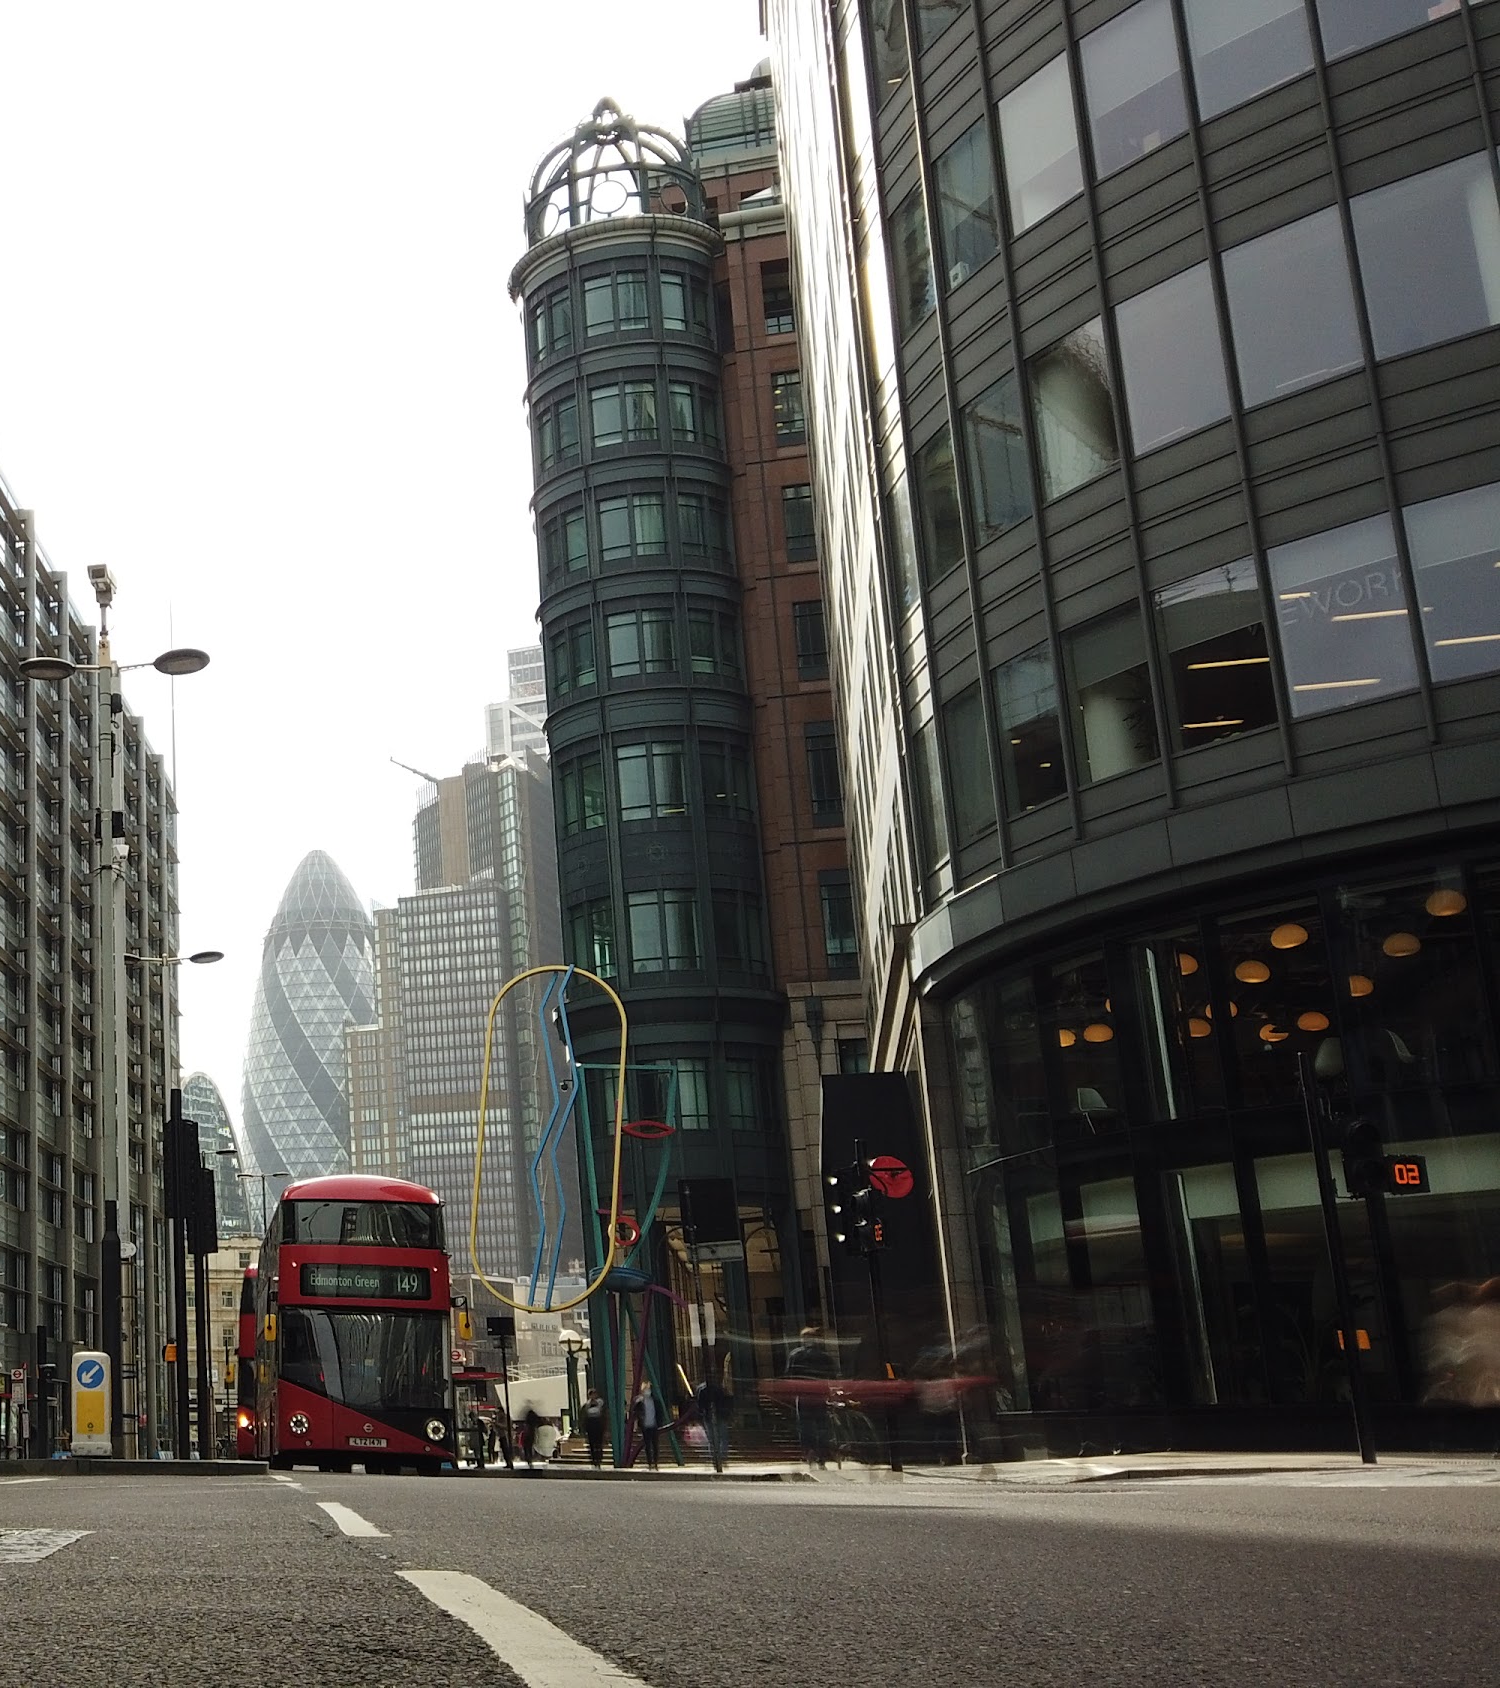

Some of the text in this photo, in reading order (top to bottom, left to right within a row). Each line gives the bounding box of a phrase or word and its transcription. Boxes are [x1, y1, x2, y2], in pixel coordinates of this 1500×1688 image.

[1395, 1164, 1420, 1184] 02
[310, 1272, 418, 1293] Edmonton Green 149
